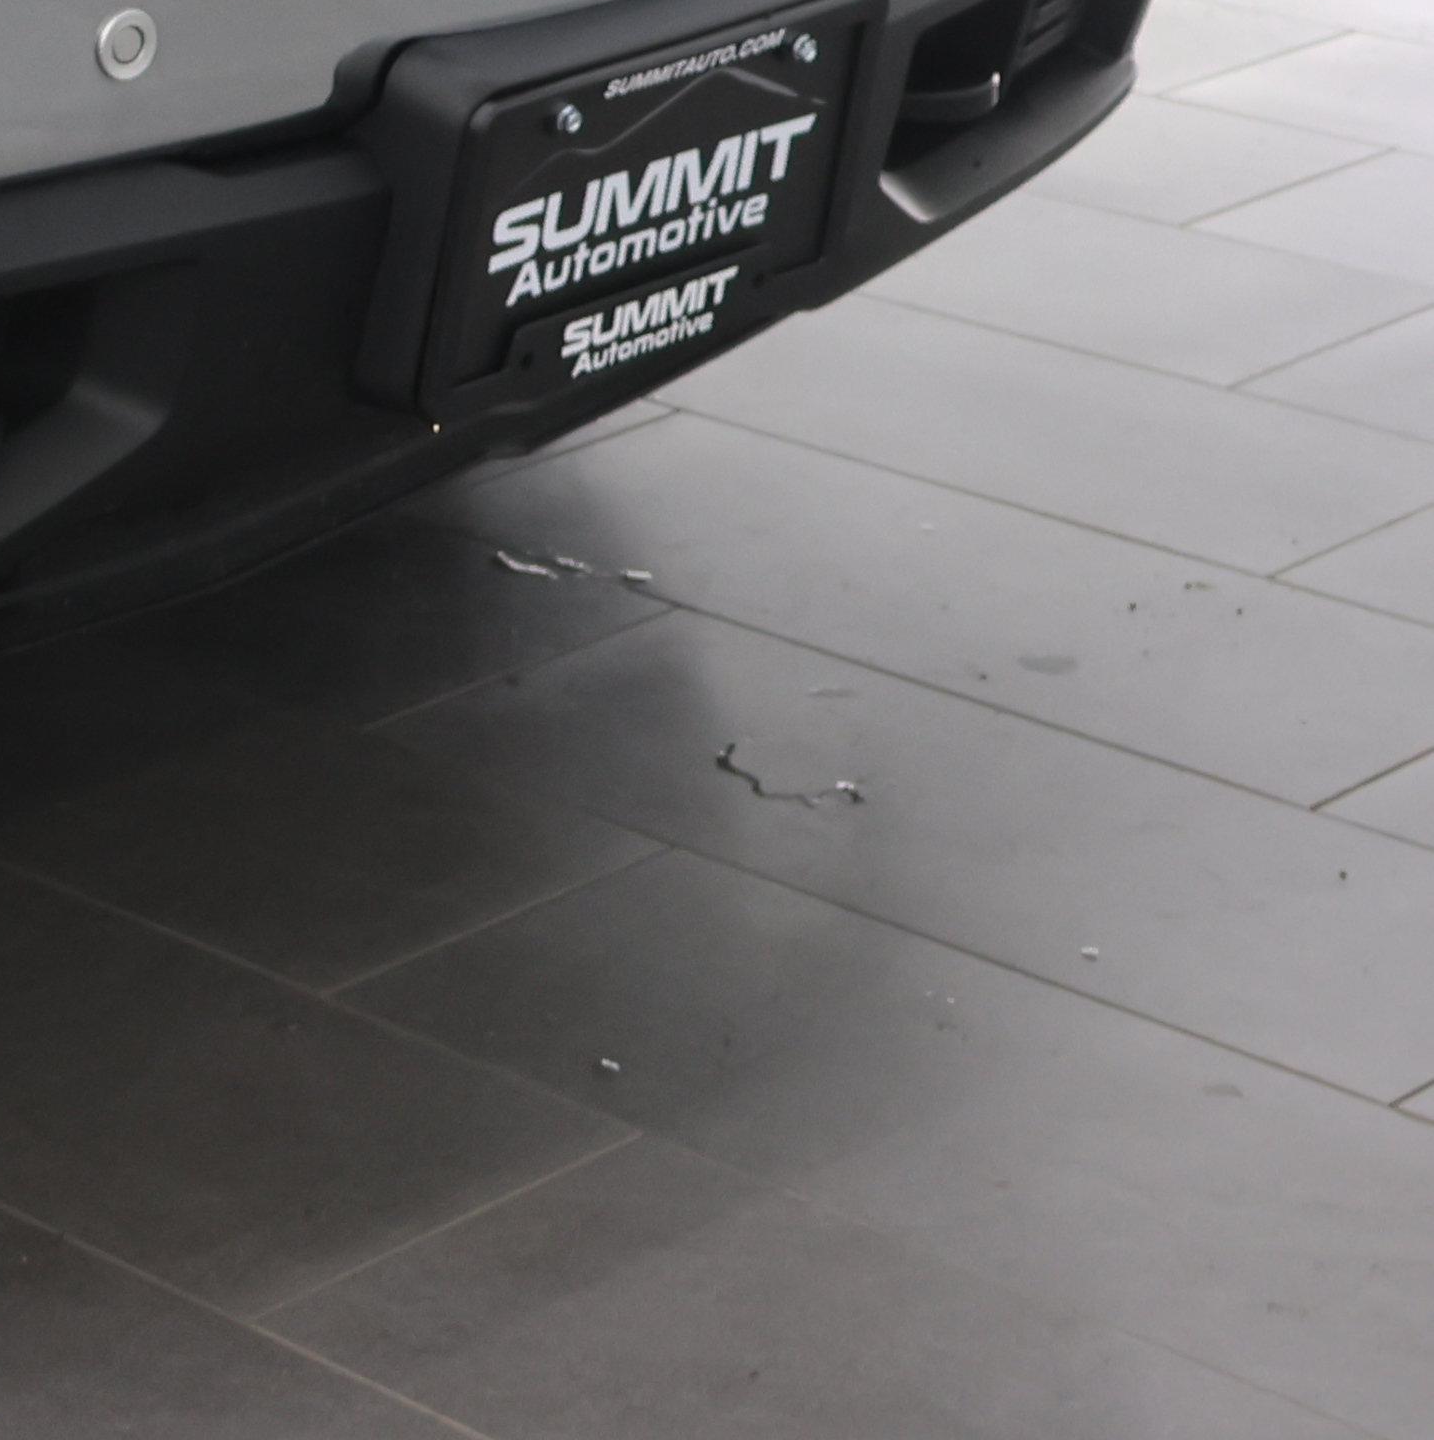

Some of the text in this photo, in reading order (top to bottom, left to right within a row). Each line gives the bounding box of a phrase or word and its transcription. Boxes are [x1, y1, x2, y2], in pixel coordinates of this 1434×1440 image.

[603, 27, 786, 100] SUMMITAUTO.COM
[487, 113, 817, 274] SUMMIT
[506, 193, 768, 308] Automotive
[561, 265, 739, 359] SUMMIT
[571, 312, 714, 379] Automotive
